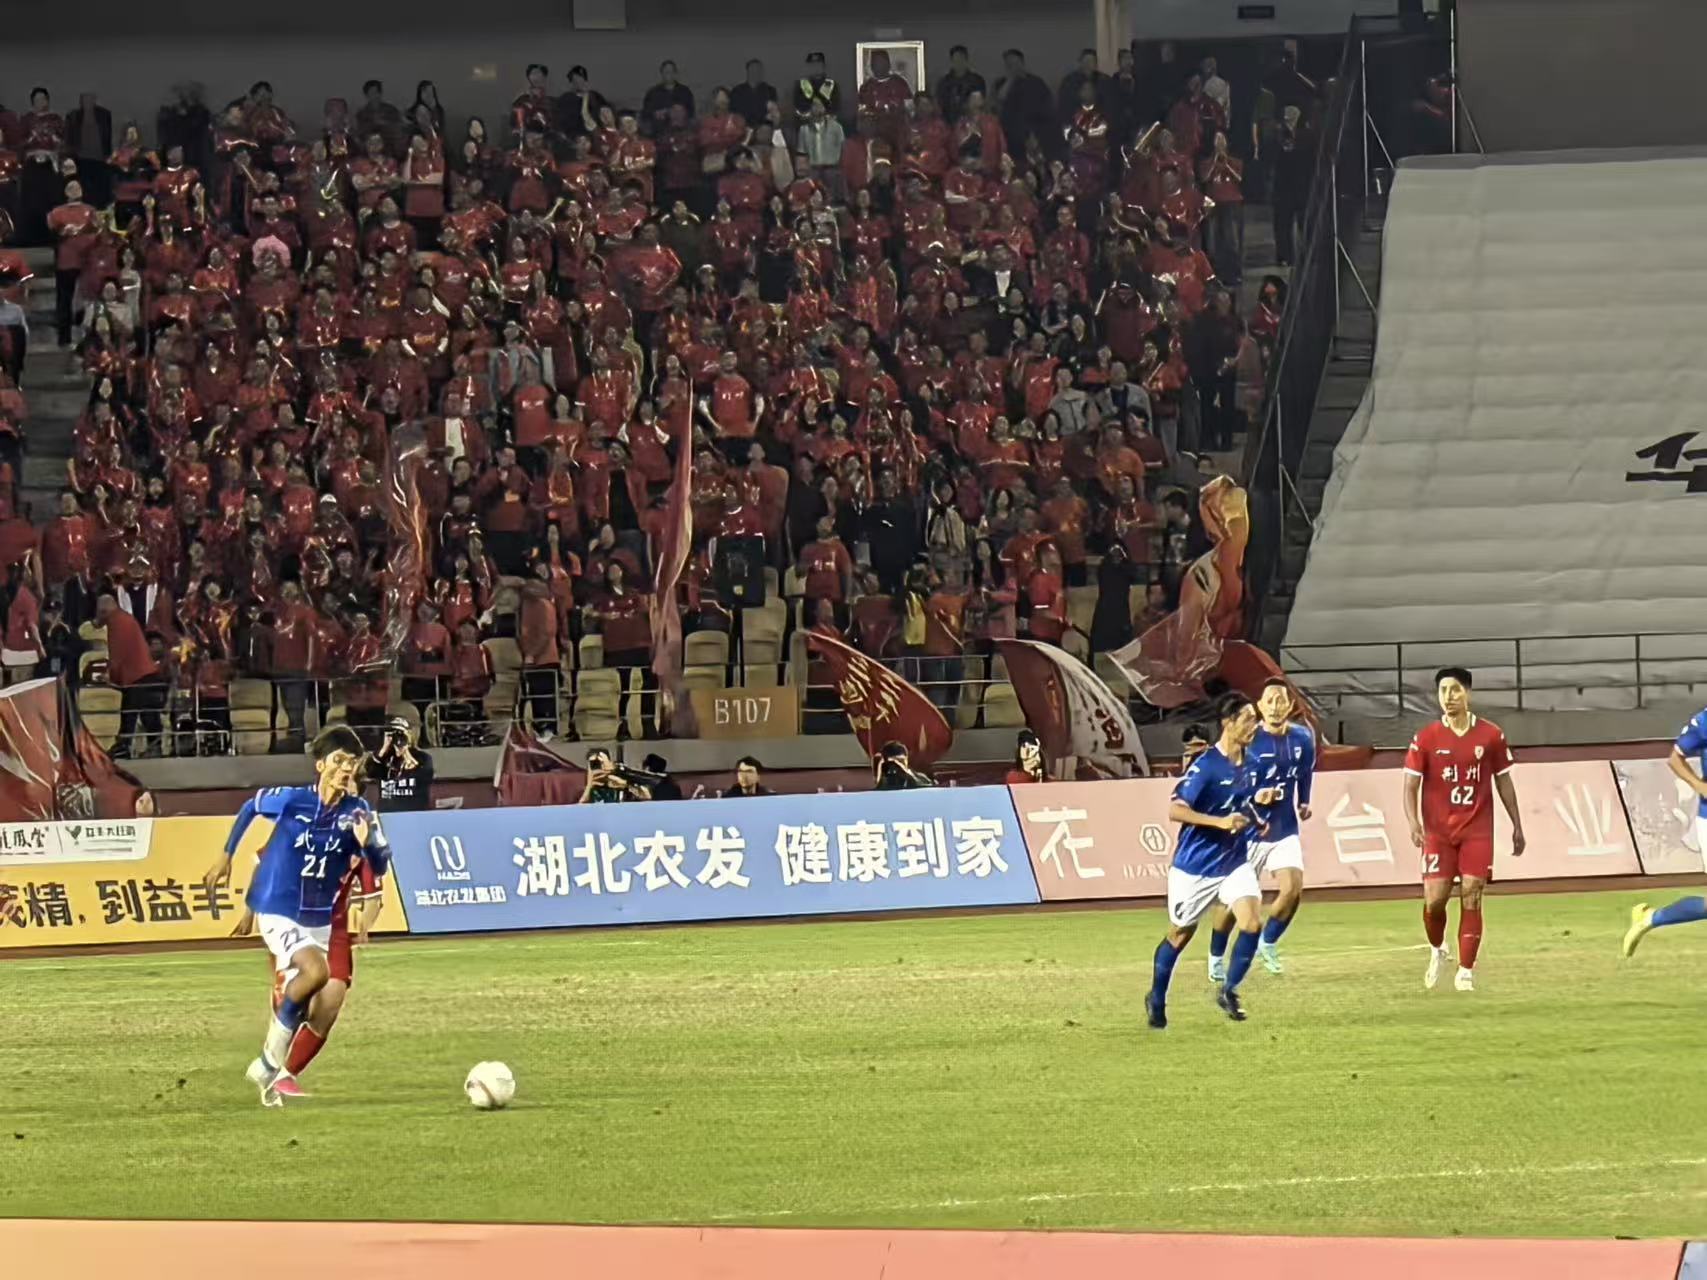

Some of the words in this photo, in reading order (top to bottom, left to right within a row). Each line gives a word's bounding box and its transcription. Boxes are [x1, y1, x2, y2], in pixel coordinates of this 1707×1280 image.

[714, 696, 772, 725] B107
[1450, 785, 1475, 806] 62
[300, 854, 327, 879] 21
[512, 825, 751, 898] 湖北农发
[774, 815, 1009, 886] 健康到家
